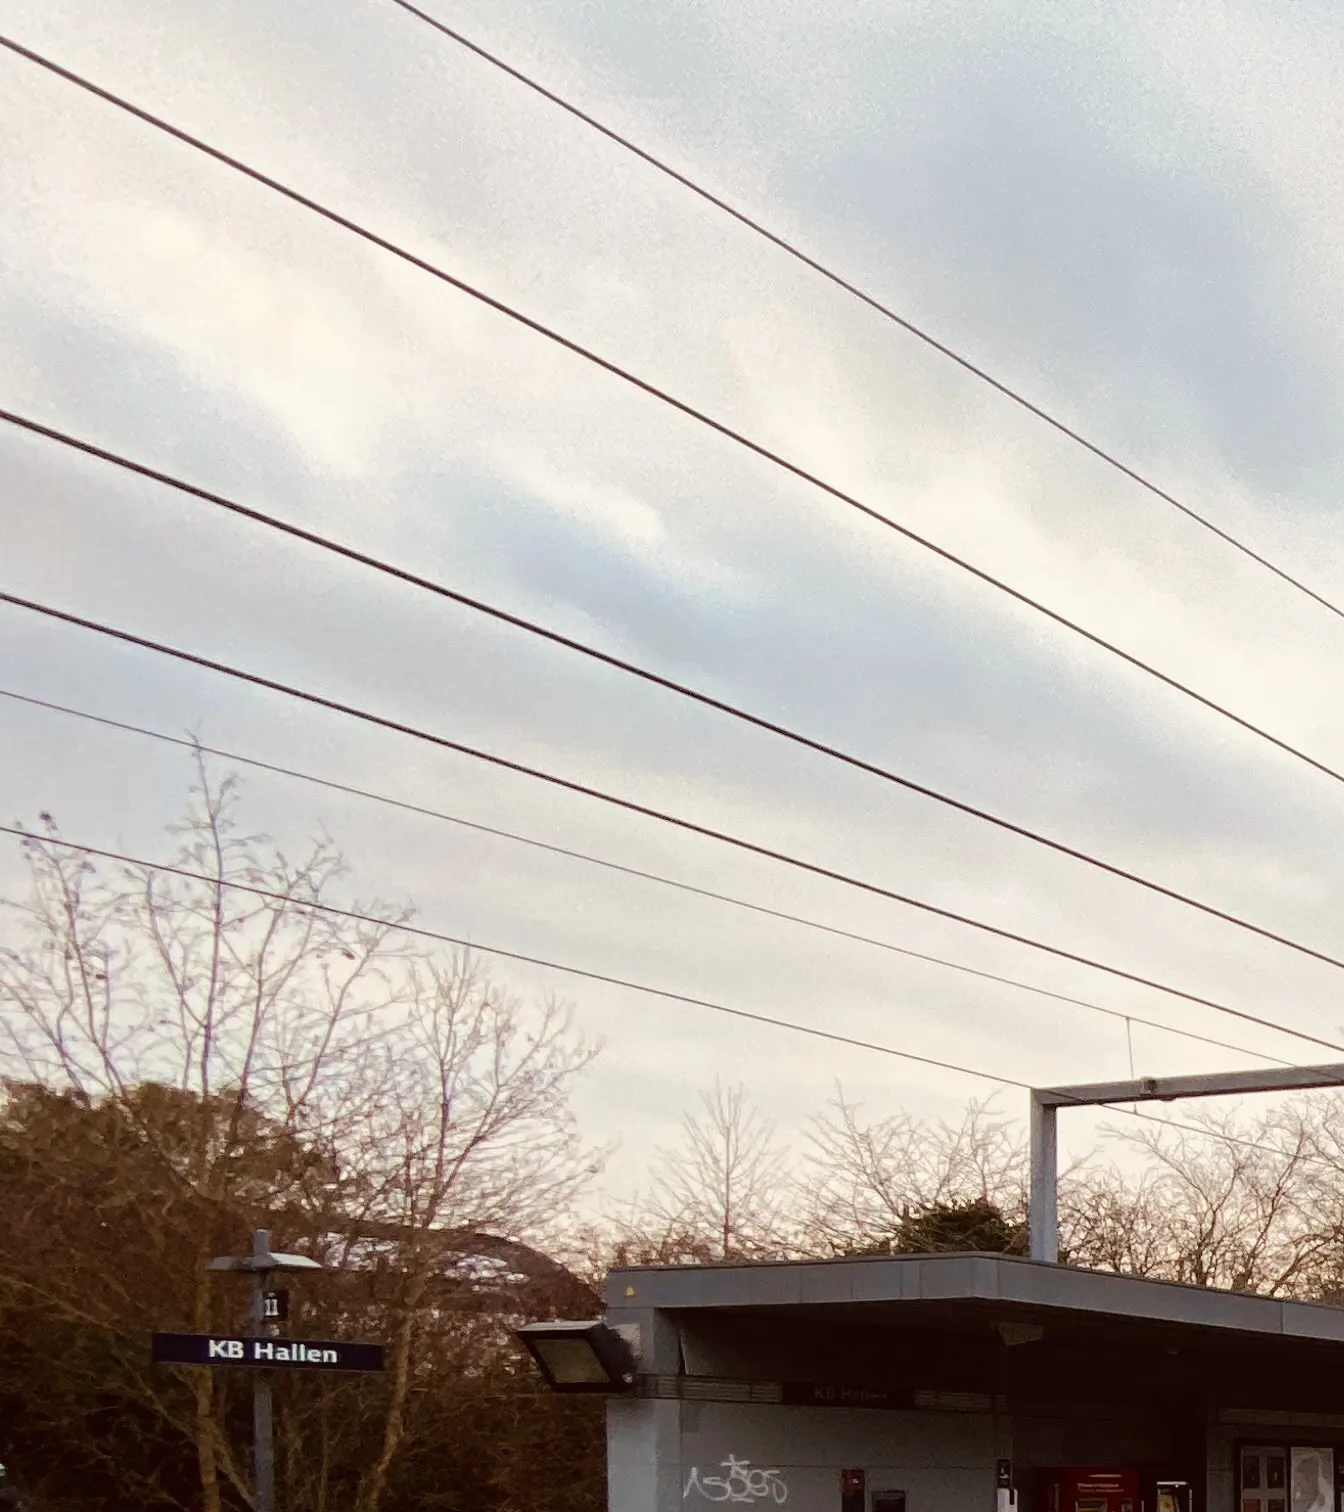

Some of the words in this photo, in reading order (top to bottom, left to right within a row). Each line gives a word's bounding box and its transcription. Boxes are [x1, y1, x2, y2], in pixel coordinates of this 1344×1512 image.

[209, 1340, 244, 1359] KB
[254, 1342, 338, 1364] Hallen
[813, 1385, 836, 1400] KB
[840, 1386, 888, 1402] Hallen
